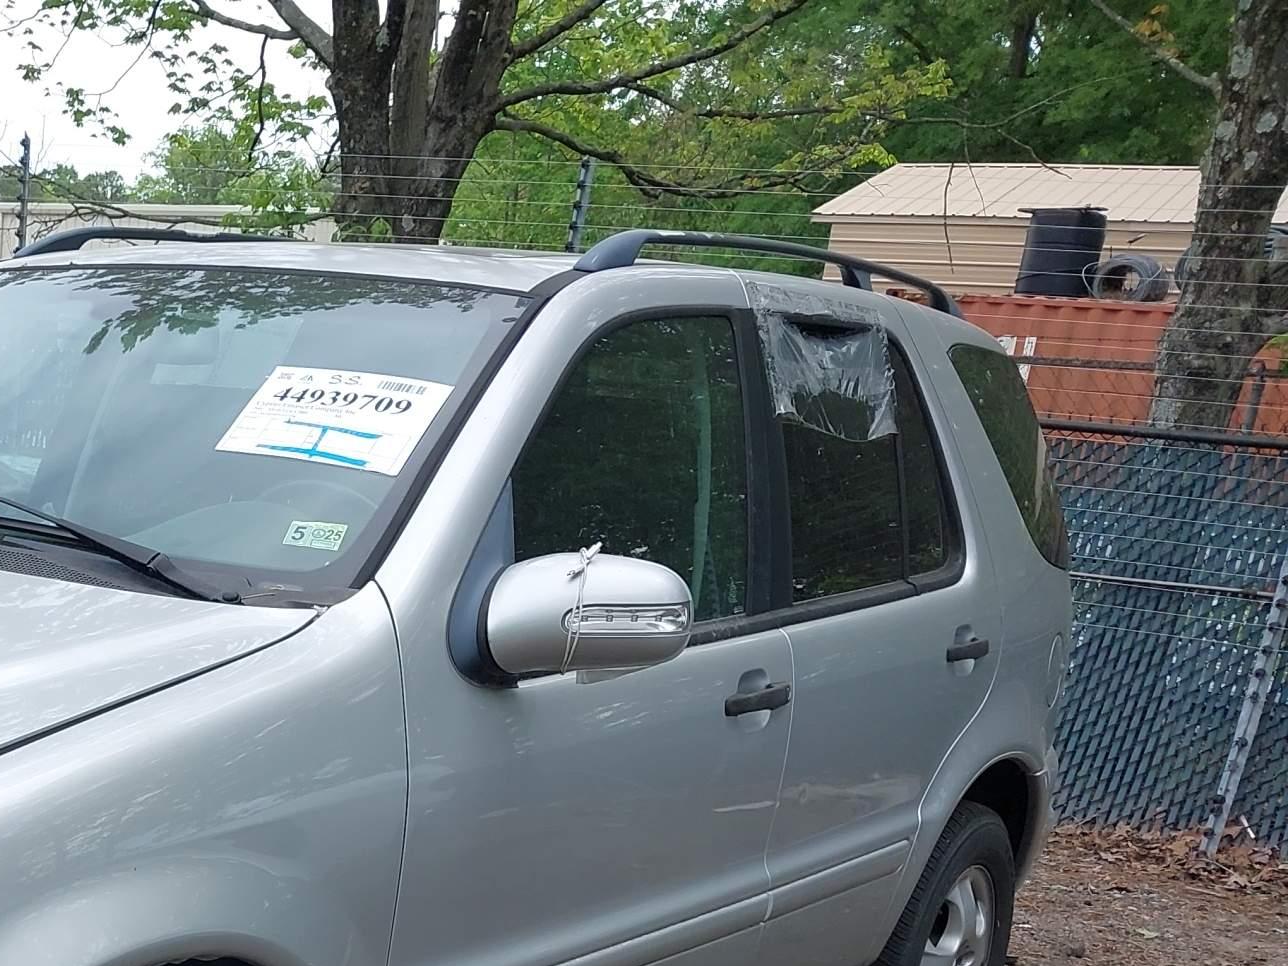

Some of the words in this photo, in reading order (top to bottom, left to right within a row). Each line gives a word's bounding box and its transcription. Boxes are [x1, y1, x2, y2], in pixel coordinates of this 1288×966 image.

[272, 386, 413, 415] 44939709
[291, 526, 308, 541] 5
[324, 529, 344, 542] 25
